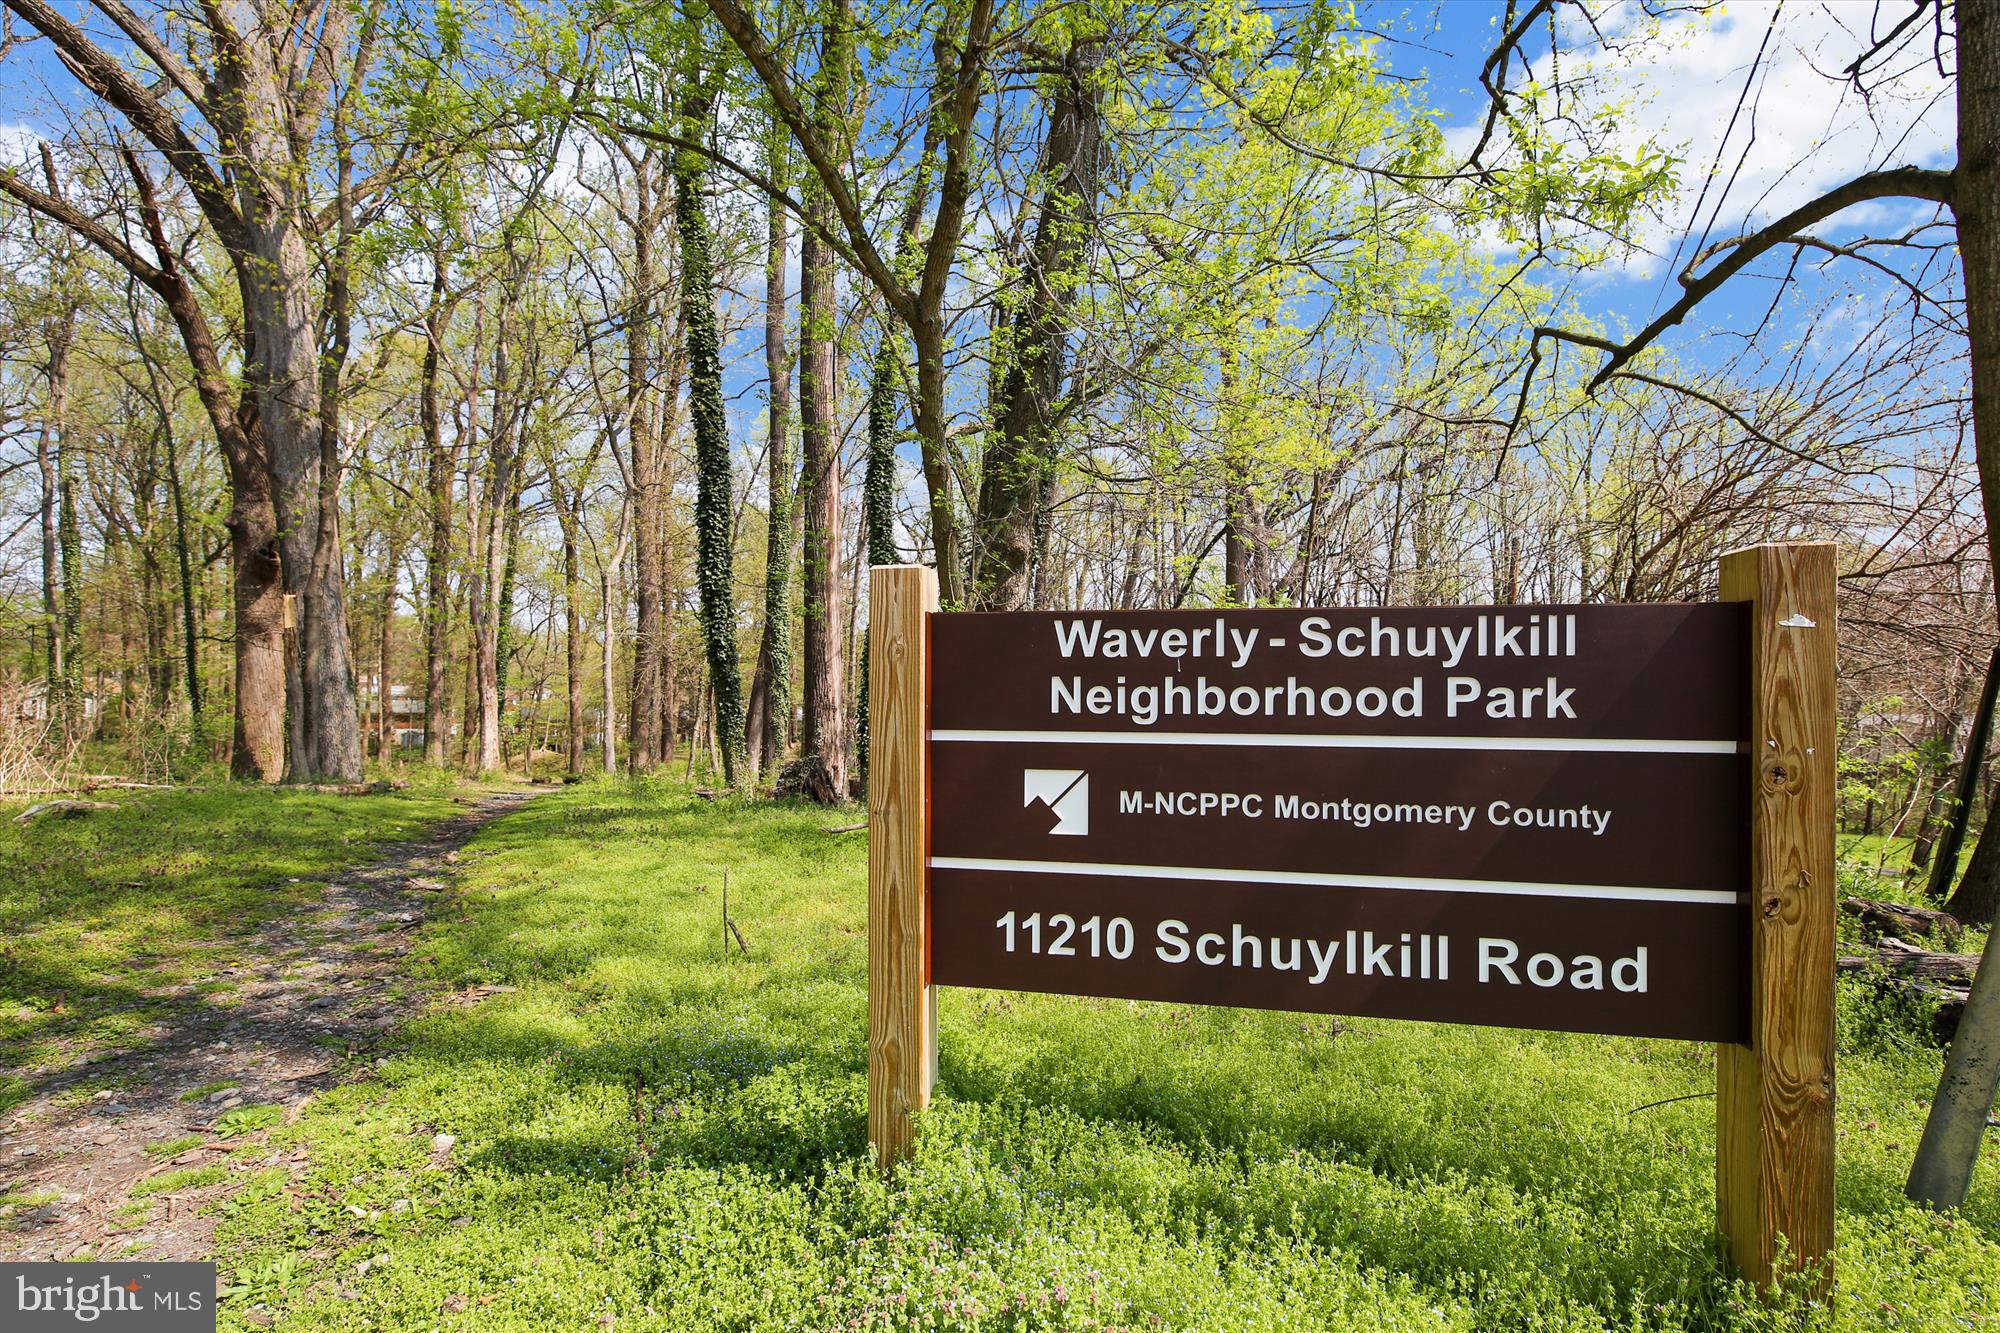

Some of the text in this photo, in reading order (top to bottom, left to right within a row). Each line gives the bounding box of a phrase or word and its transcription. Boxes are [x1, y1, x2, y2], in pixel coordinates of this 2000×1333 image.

[1053, 618, 1260, 669] Waverly
[1298, 614, 1577, 669] Schuylkill
[1050, 676, 1578, 726] Neighborhood Park
[1119, 790, 1613, 837] M-NCPPC Montgomery County
[996, 911, 1649, 994] 11210 Schuylkill Road
